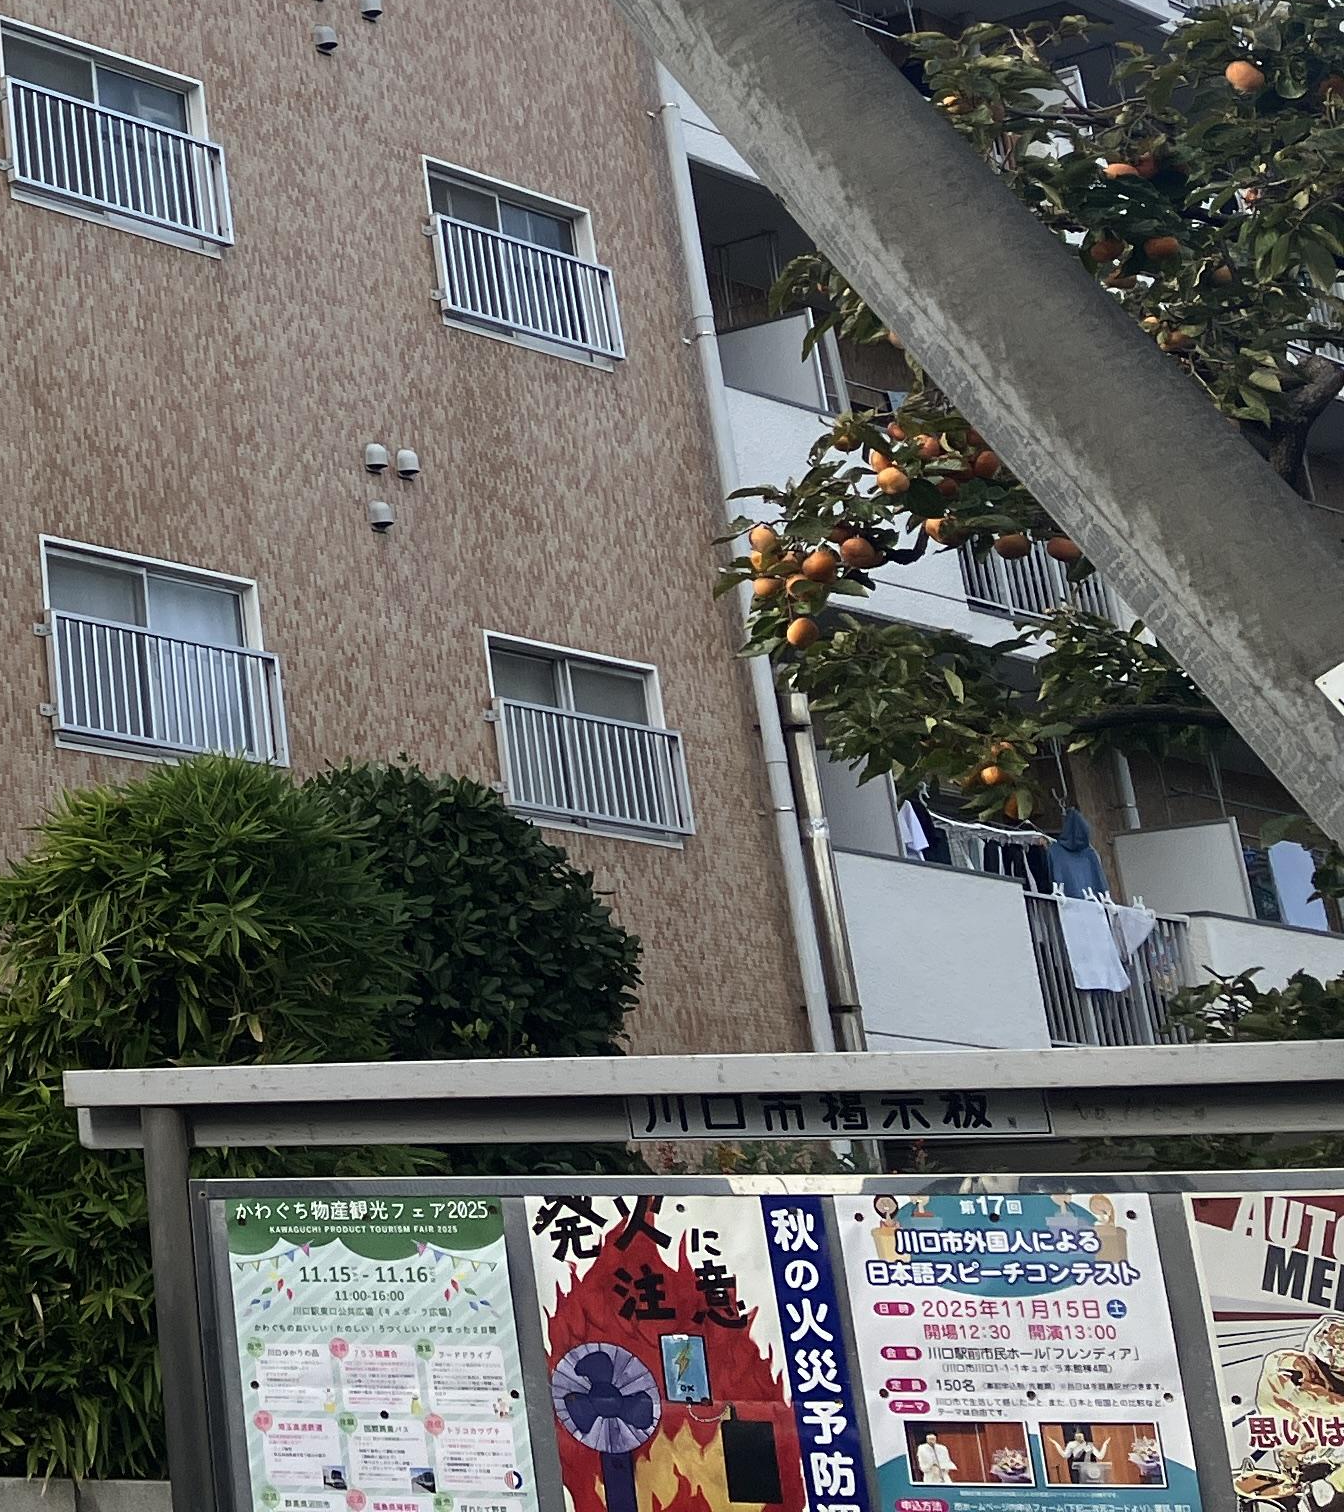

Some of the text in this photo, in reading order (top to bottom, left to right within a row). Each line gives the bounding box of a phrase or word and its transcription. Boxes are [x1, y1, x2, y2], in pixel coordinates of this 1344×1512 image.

[645, 1091, 992, 1132] 川口市掲示板
[235, 1200, 489, 1221] かわぐち物産観光フェア2025
[959, 1196, 1023, 1216] 第17回
[269, 1225, 458, 1234] KAWAGUCHI PRODUCT TOURISM FAIR 2025
[1231, 1196, 1344, 1261] AUT
[895, 1228, 1102, 1255] 川口市外国人による
[299, 1266, 351, 1283] 11.15
[375, 1266, 428, 1283] 11.16
[866, 1260, 1141, 1287] 日本語スピーチコンテスト
[1261, 1244, 1344, 1313] ME
[335, 1290, 405, 1302] 11:00-16:00
[921, 1299, 1101, 1320] 2025年11月15日
[924, 1324, 1117, 1340] 開場12:30 開演13:00
[769, 1207, 860, 1512] 秋の火災予防
[936, 1379, 976, 1392] 150名
